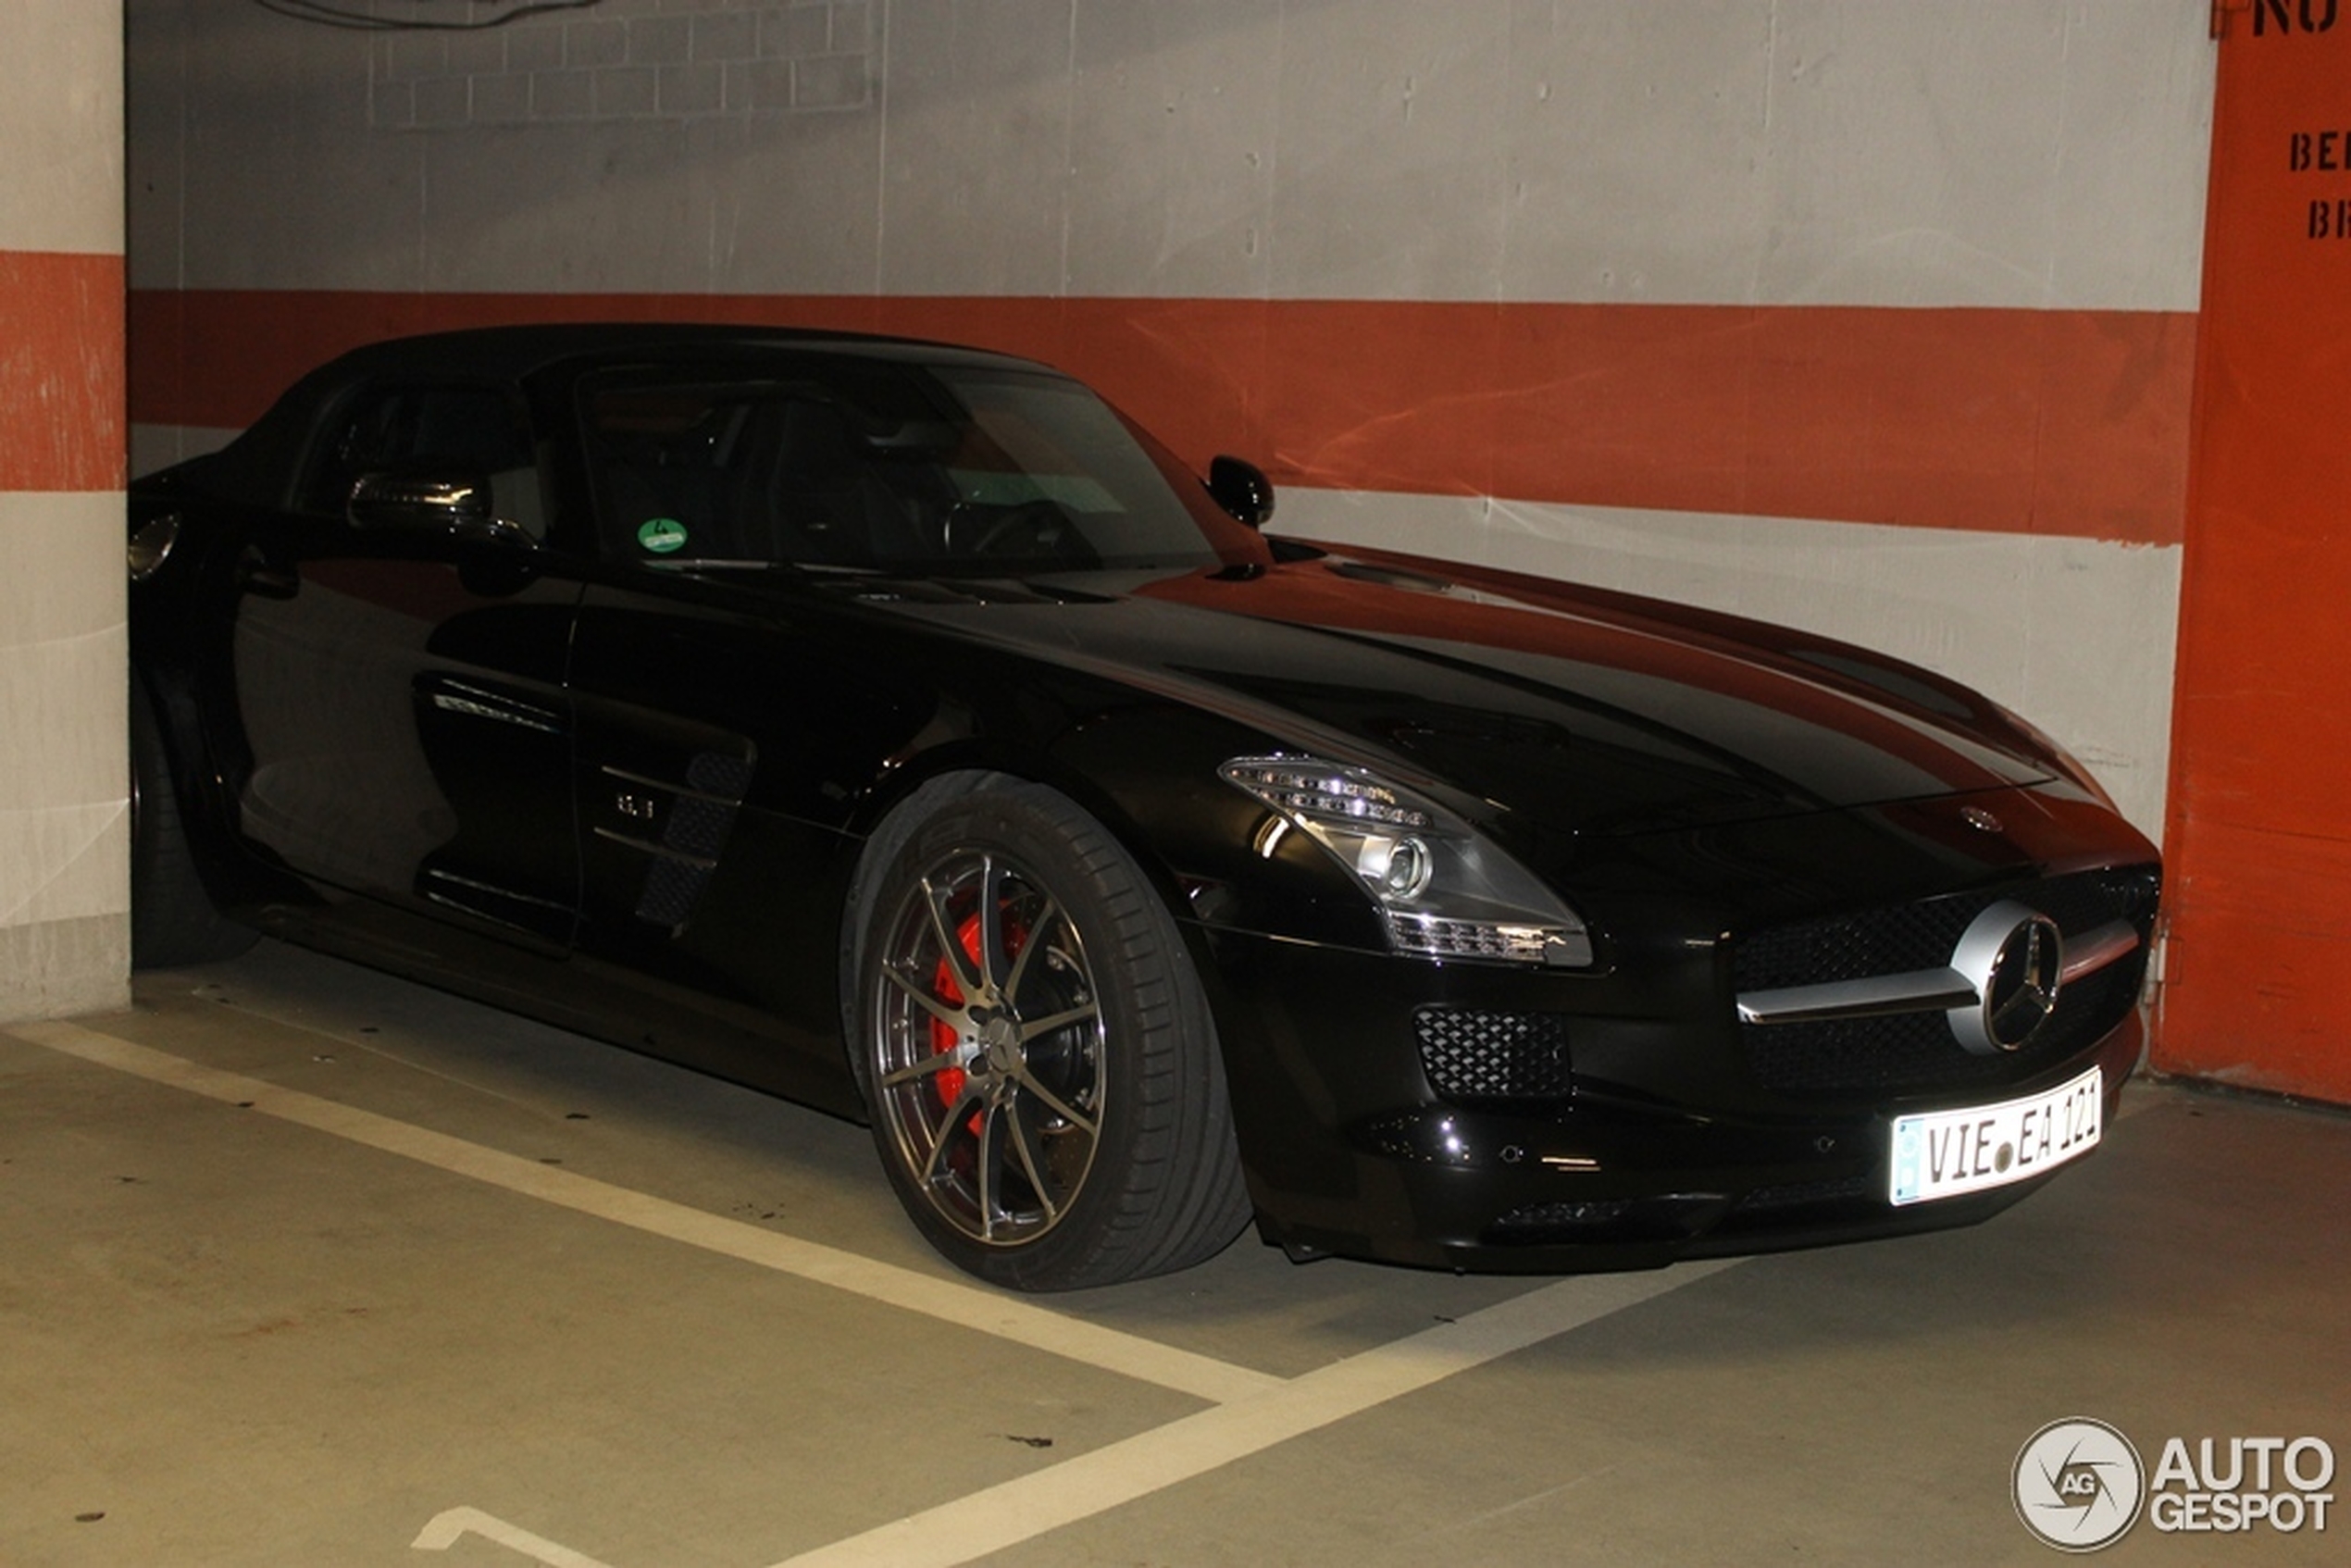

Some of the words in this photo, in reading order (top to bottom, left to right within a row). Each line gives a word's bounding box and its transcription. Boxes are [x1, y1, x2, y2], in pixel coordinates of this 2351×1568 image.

[1930, 1119, 1996, 1184] VIE
[2018, 1104, 2052, 1165] EA
[2060, 1081, 2096, 1150] 121
